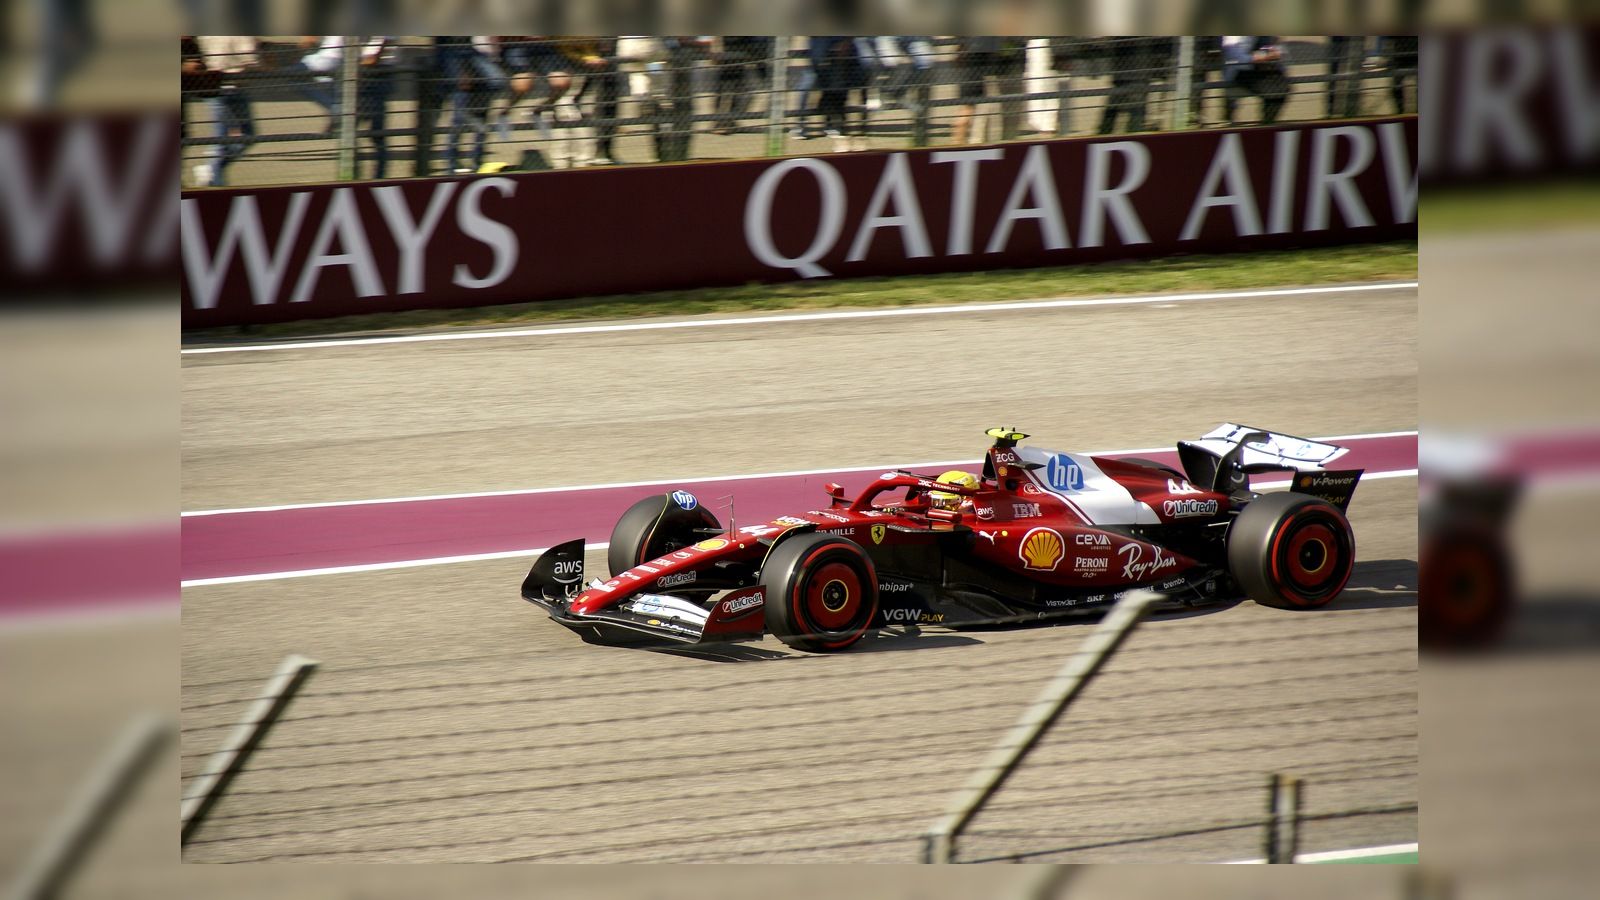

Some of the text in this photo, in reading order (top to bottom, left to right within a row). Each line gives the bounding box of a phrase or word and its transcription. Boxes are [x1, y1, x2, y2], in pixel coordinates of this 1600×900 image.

[744, 141, 1152, 278] QATAR
[181, 177, 519, 309] WAYS
[1053, 453, 1079, 493] hp
[1312, 477, 1355, 487] V-Power
[677, 491, 693, 510] hp
[1175, 499, 1218, 515] UniCredit
[977, 507, 994, 515] aws
[1012, 503, 1042, 518] IBM
[829, 526, 855, 536] MILLE
[553, 560, 583, 574] aws
[1074, 556, 1108, 568] PERONI
[1118, 542, 1177, 581] Ray-Ban
[665, 571, 697, 586] UniCredit
[879, 582, 909, 592] mbipar
[730, 593, 763, 611] UniCredit
[1087, 594, 1105, 603] SKF
[883, 608, 944, 622] VGW PLAY
